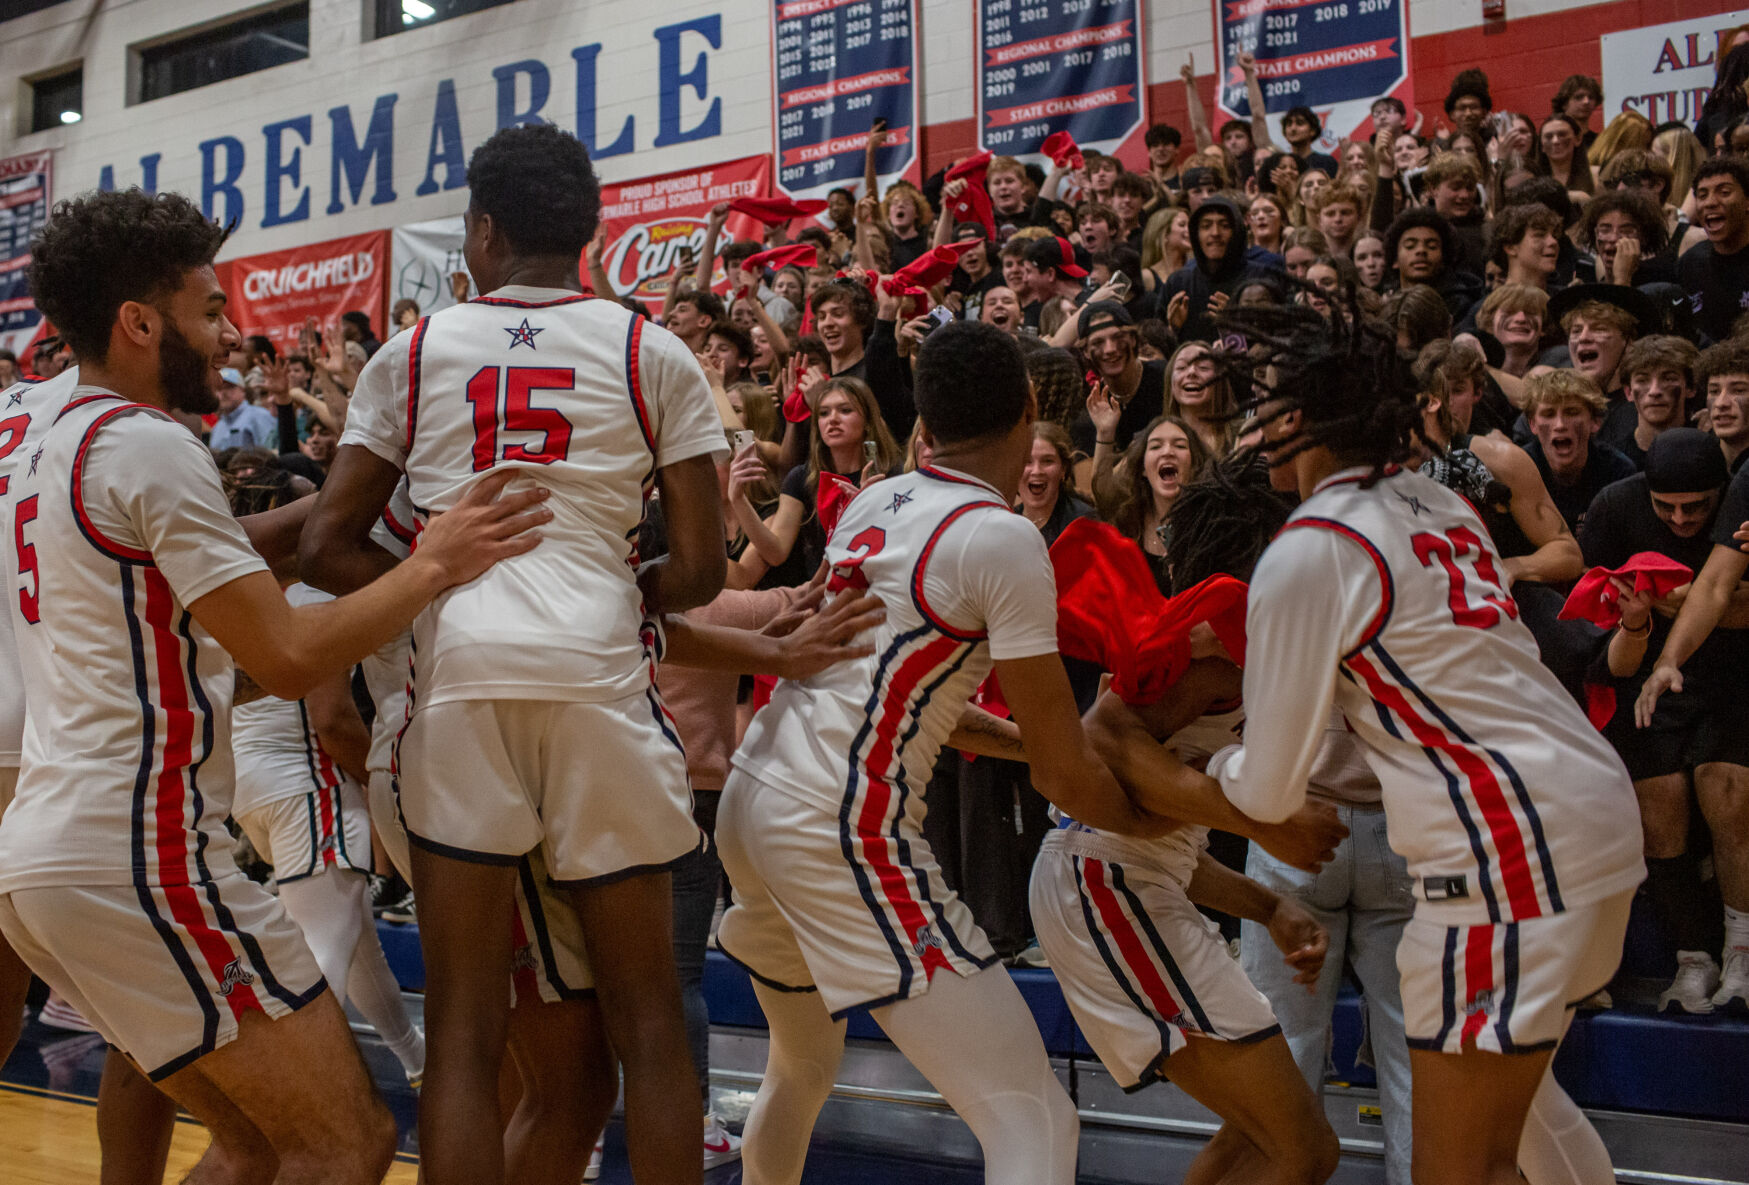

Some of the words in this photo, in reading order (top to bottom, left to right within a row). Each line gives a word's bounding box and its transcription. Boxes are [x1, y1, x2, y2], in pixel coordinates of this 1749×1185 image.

[811, 13, 836, 28] 1995
[848, 4, 873, 19] 1996
[881, 11, 908, 26] 2014
[987, 16, 1010, 32] 2011
[1020, 8, 1049, 23] 2012
[1267, 15, 1299, 30] 2017
[1316, 5, 1349, 22] 2018
[1359, 0, 1392, 14] 2019
[847, 34, 872, 49] 2017
[987, 31, 1013, 47] 2016
[998, 41, 1052, 61] REGIONAL
[1056, 26, 1123, 49] CHAMPIONS
[1267, 32, 1298, 47] 2021
[987, 68, 1017, 84] 2000
[1023, 61, 1051, 77] 2001
[1065, 52, 1094, 68] 2017
[1104, 43, 1132, 61] 2018
[1254, 61, 1292, 76] STATE
[1296, 46, 1377, 71] CHAMPIONS
[839, 72, 901, 93] CHAMPIONS
[987, 83, 1015, 98] 2019
[1267, 80, 1301, 97] 2020
[782, 111, 804, 126] 2017
[847, 95, 873, 111] 2019
[1011, 107, 1043, 122] STATE
[1047, 91, 1118, 114] CHAMPIONS
[782, 126, 804, 140] 2021
[988, 130, 1015, 145] 2017
[1022, 124, 1050, 140] 2019
[801, 142, 829, 160] STATE
[783, 167, 806, 182] 2017
[814, 159, 836, 175] 2019
[621, 184, 653, 201] PROUD
[655, 175, 699, 196] SPONSOR
[701, 172, 714, 188] OF
[643, 196, 666, 214] HIGH
[668, 189, 705, 209] SCHOOL
[708, 181, 757, 201] ATHLETES
[652, 224, 694, 242] Raising
[244, 253, 375, 301] CRUTCHFIELD
[466, 365, 576, 473] 15
[15, 492, 40, 625] 5
[826, 525, 887, 595] 2
